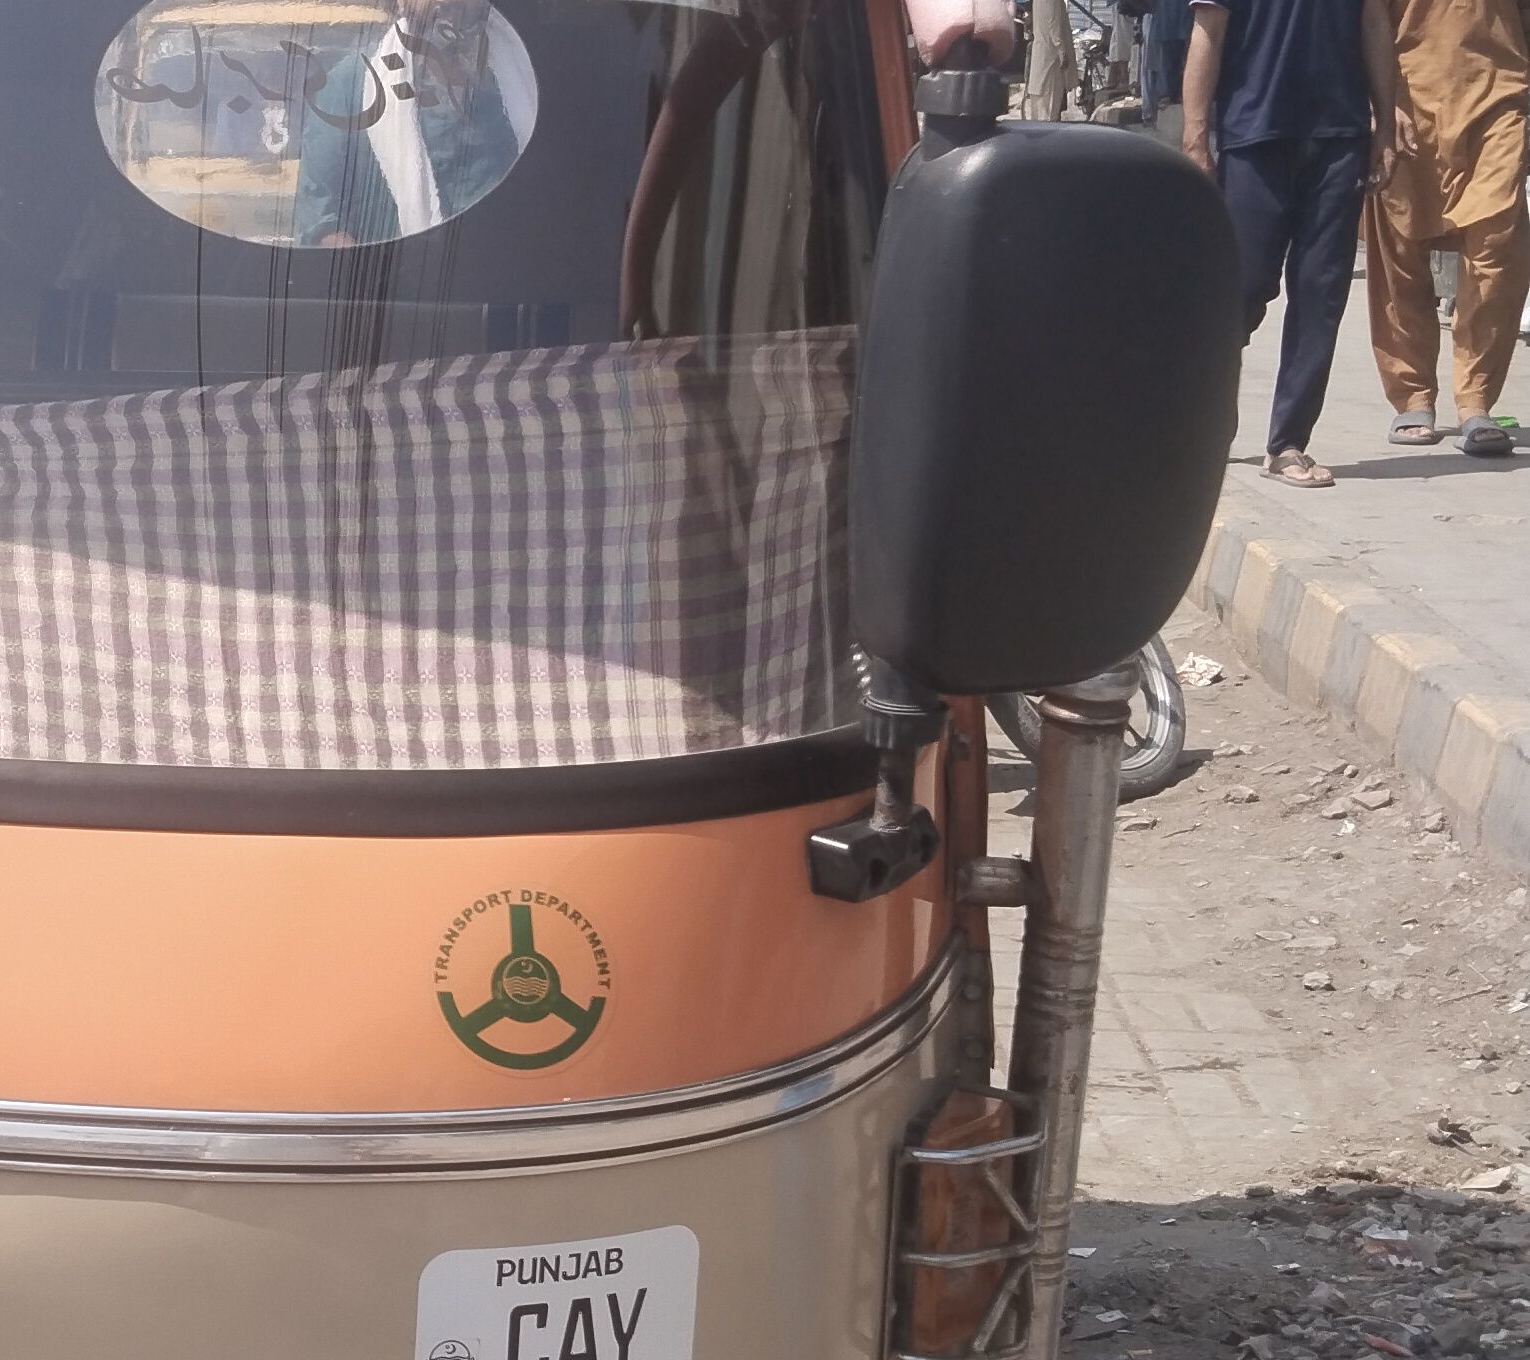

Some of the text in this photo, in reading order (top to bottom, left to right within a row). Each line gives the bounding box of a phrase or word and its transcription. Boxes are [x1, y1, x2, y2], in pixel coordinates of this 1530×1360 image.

[433, 889, 611, 990] TRANSPORT DEPARTMENT
[496, 1247, 624, 1287] PUNJAB
